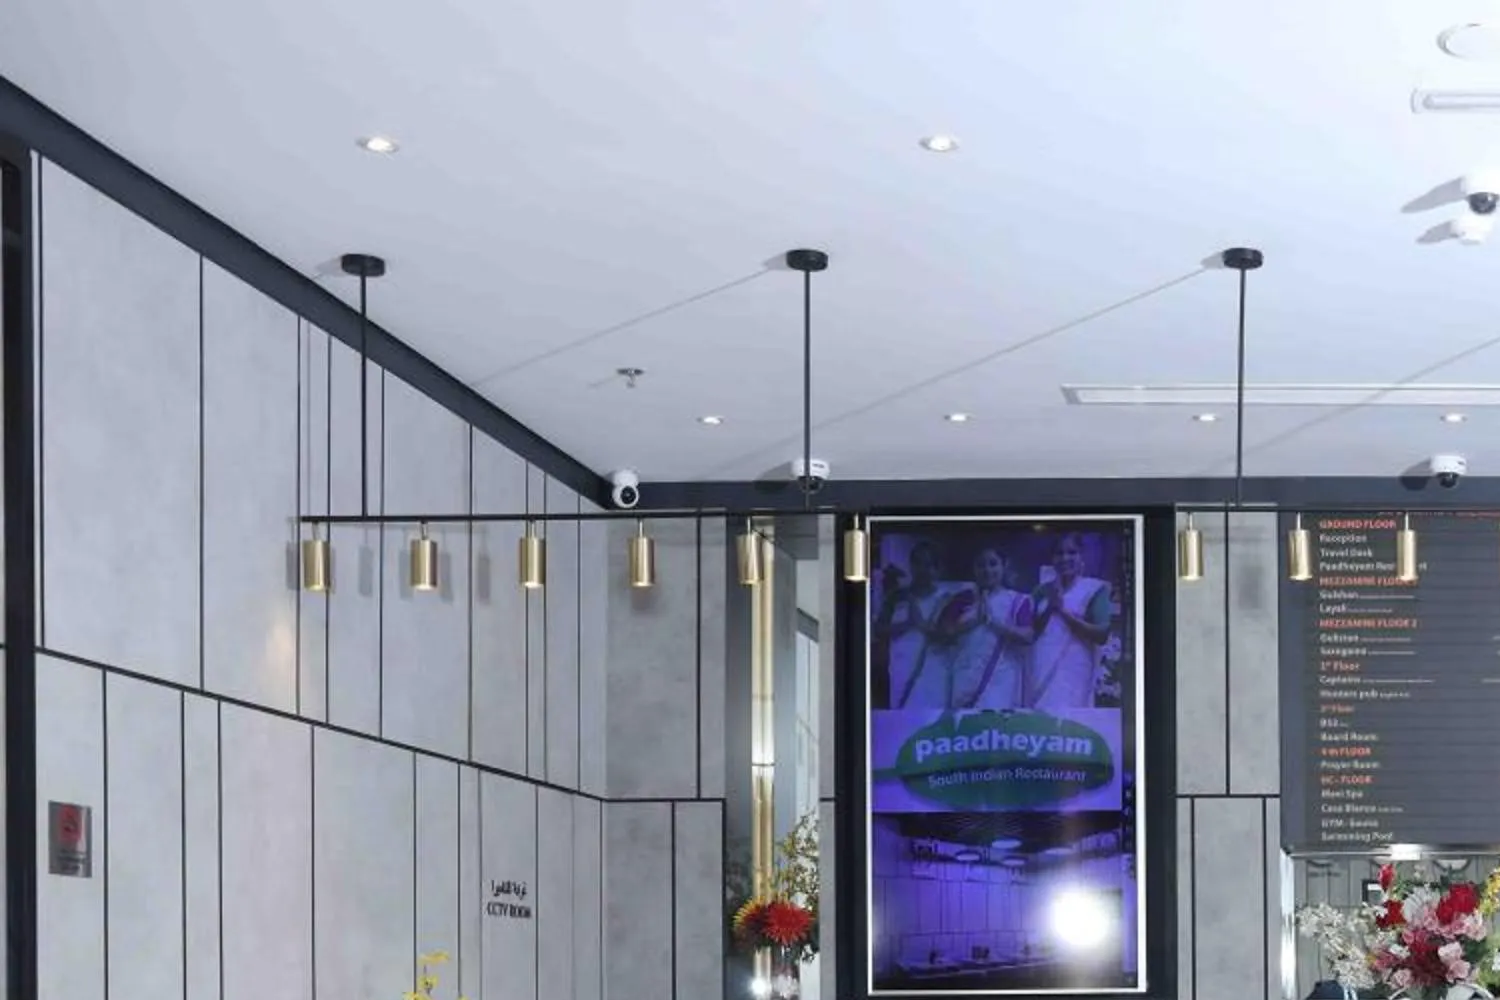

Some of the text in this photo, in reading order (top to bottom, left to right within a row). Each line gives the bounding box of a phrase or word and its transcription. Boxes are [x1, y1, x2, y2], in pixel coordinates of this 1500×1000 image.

[916, 728, 1093, 763] paadheyam
[928, 766, 1086, 788] South Indian Restaurant
[487, 901, 509, 917] CCTV
